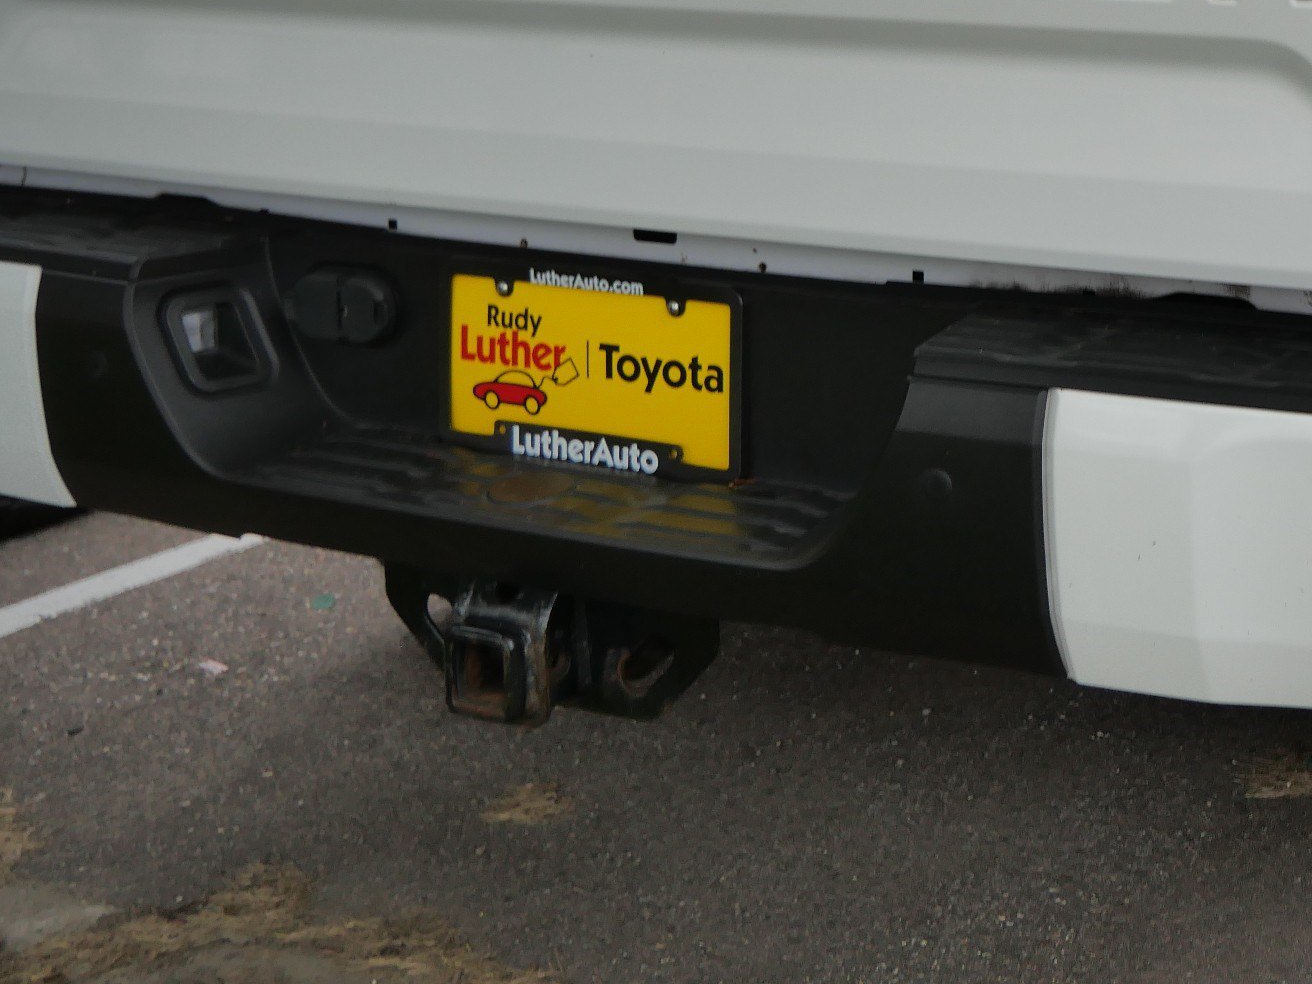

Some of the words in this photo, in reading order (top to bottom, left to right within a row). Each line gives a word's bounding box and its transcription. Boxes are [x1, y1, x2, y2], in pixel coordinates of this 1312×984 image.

[529, 267, 645, 296] LutherAuto.com
[487, 304, 542, 337] Rudy
[461, 325, 566, 371] Luther
[599, 343, 724, 393] Toyota
[511, 424, 659, 475] LutherAuto
